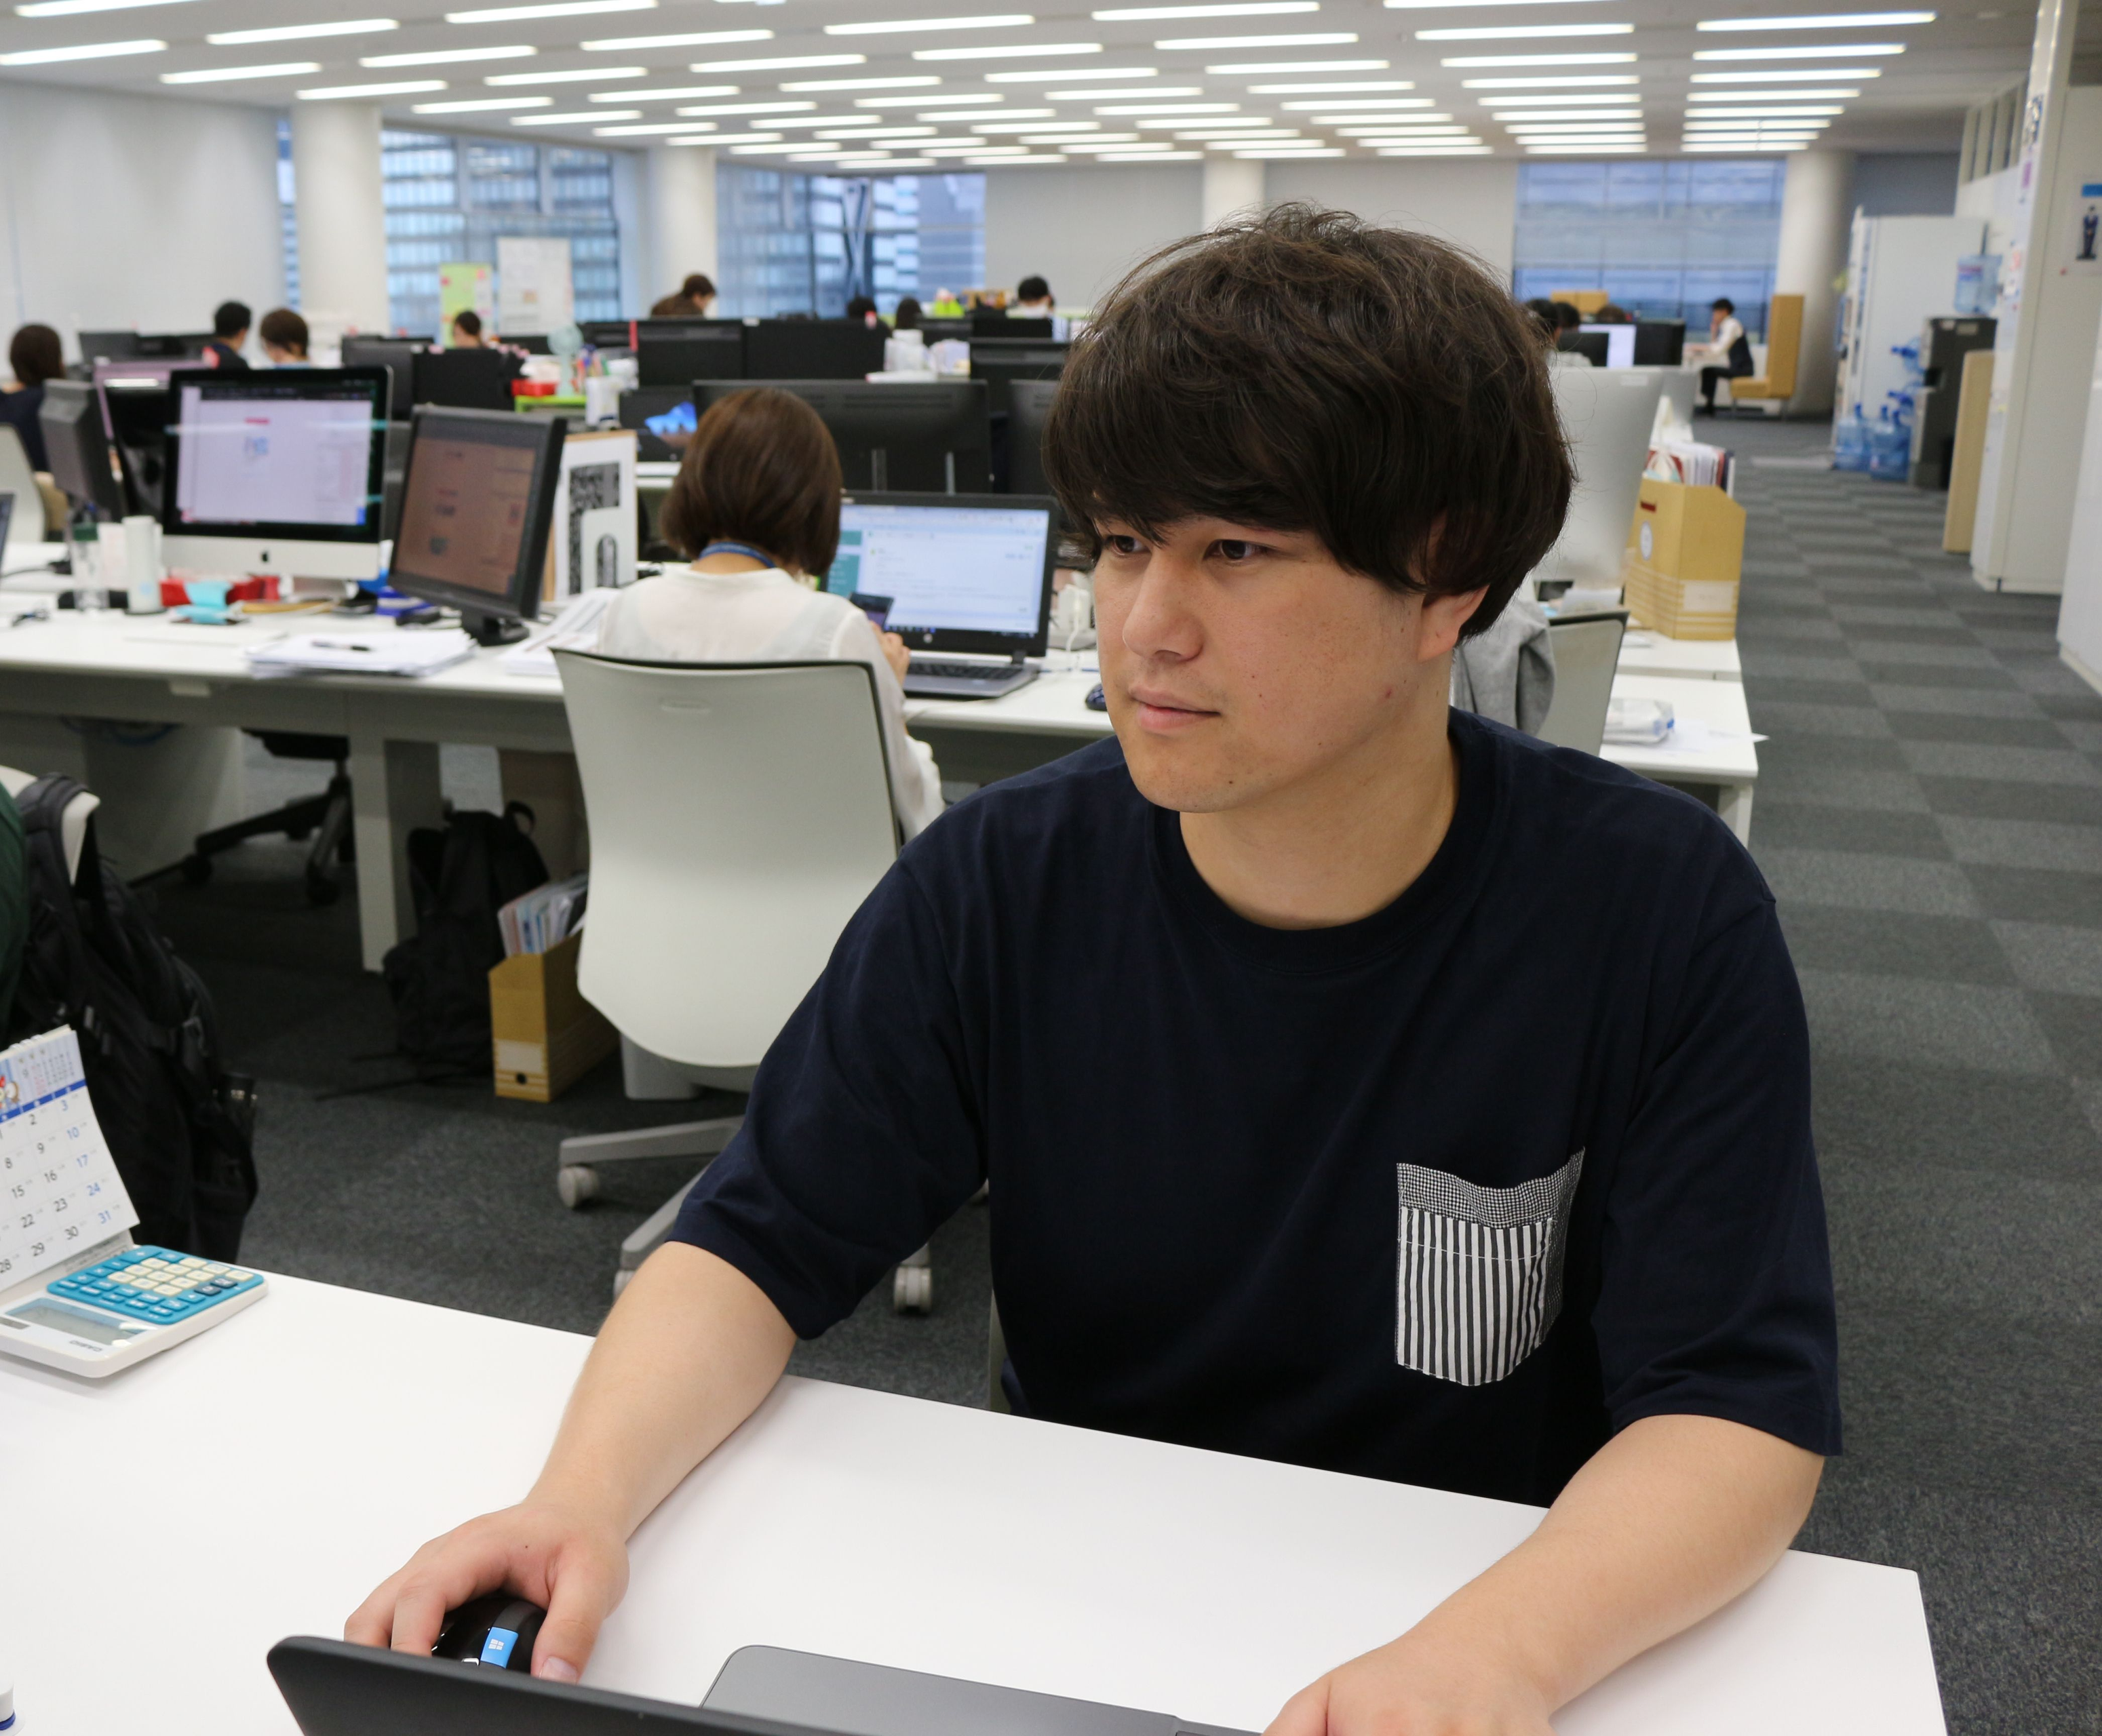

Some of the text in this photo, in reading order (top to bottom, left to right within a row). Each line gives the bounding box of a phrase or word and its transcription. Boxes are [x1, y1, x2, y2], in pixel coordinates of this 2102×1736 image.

[28, 1113, 37, 1126] 2
[61, 1100, 69, 1111] 3
[5, 1126, 80, 1169] 8 9 10
[12, 1154, 88, 1199] 15 16 17
[20, 1183, 100, 1229] 22 23 24
[31, 1242, 45, 1257] 29
[64, 1226, 79, 1240] 30
[98, 1210, 111, 1224] 31
